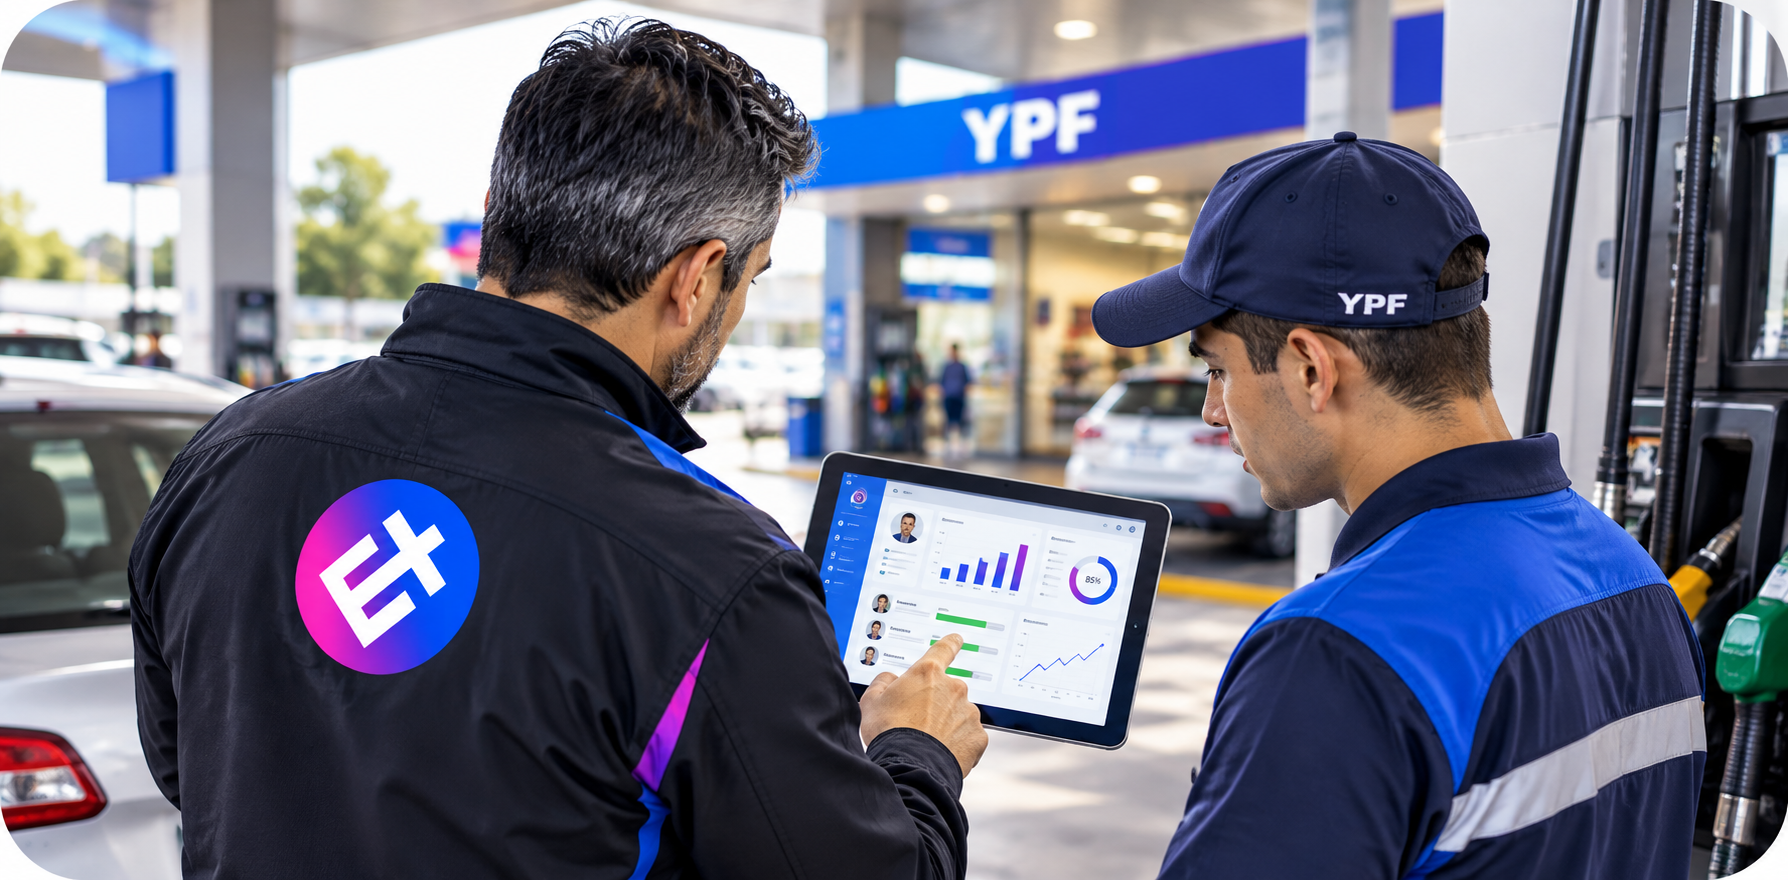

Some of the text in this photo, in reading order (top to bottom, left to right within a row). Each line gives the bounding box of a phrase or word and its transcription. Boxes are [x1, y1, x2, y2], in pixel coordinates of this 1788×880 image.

[961, 89, 1100, 164] YPF
[1338, 292, 1408, 315] YPF
[1085, 575, 1102, 585] 85%
